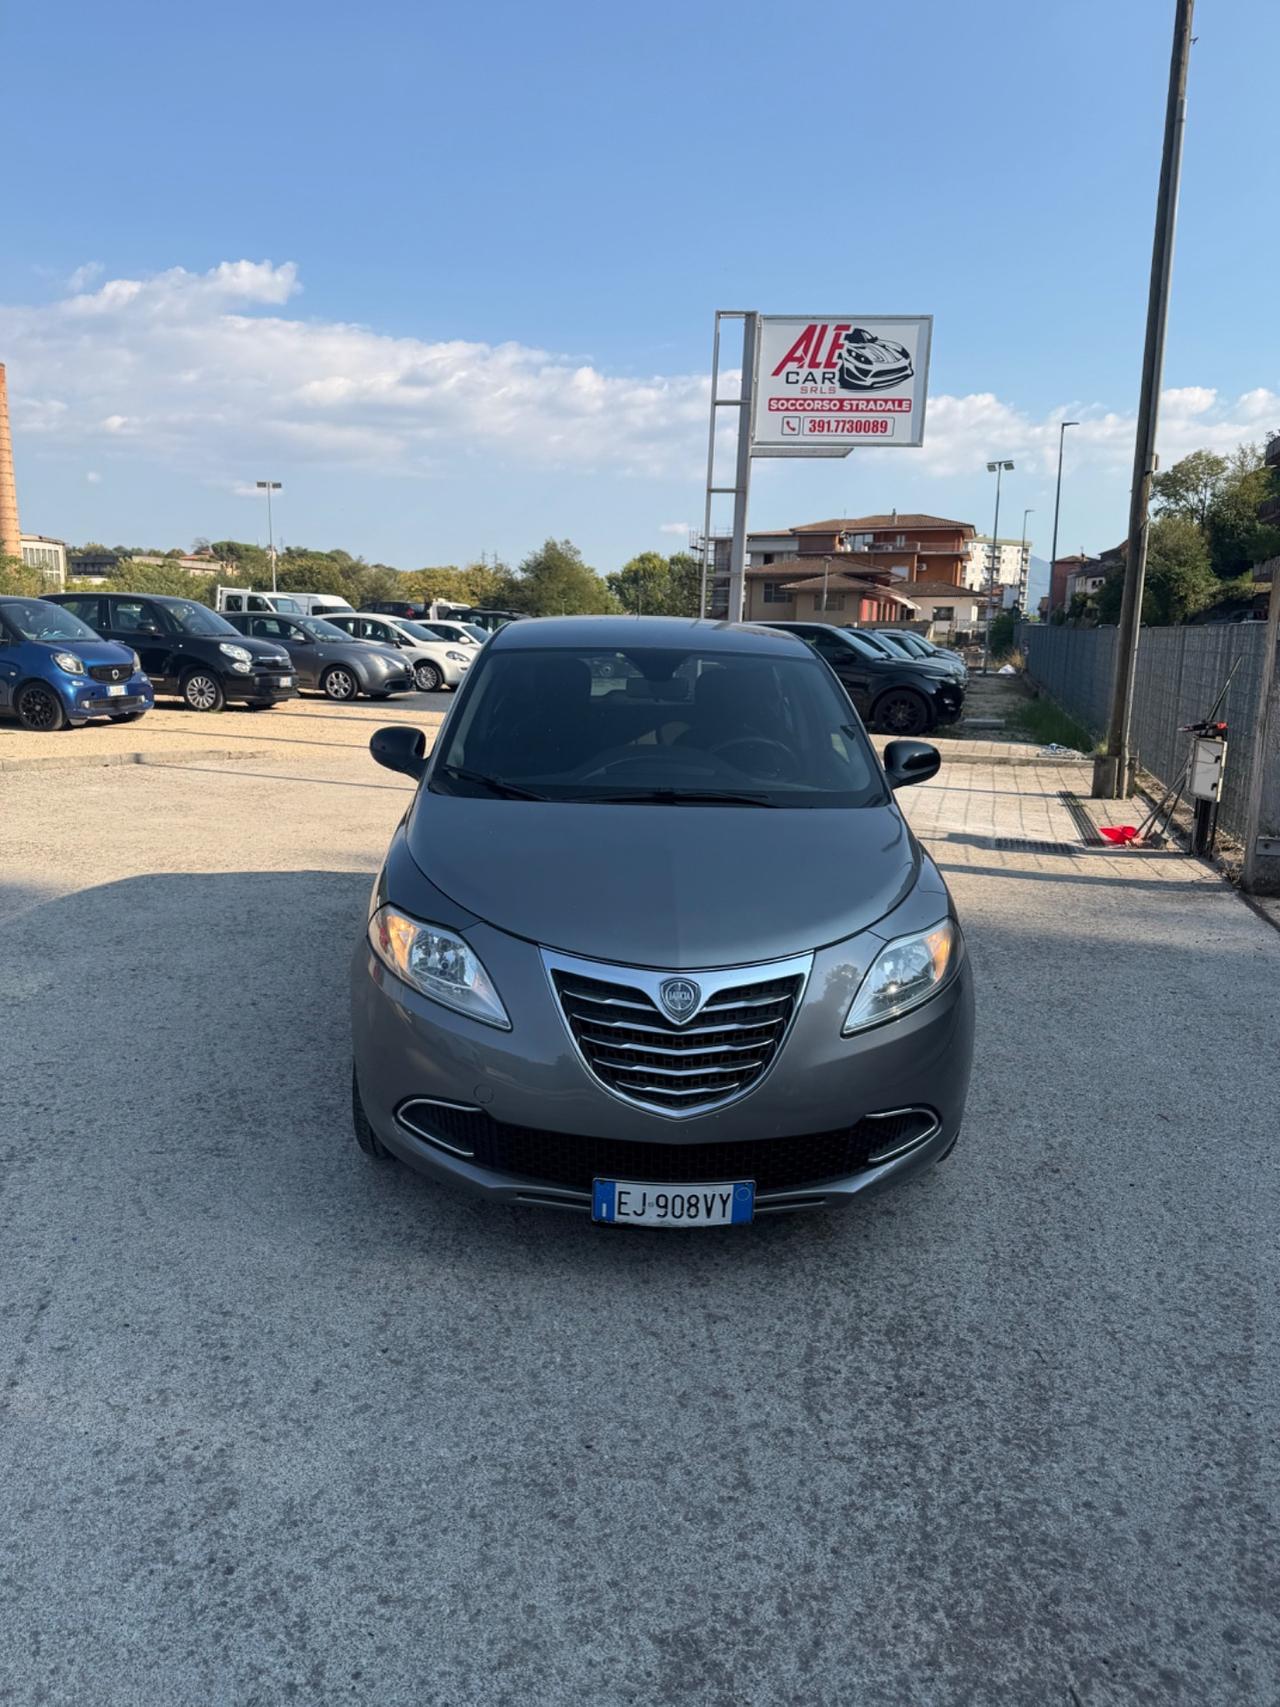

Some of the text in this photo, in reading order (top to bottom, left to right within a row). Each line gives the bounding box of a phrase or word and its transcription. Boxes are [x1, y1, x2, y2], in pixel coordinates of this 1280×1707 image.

[771, 324, 852, 377] ALE
[785, 371, 836, 385] CAR
[800, 386, 836, 394] SRLS
[770, 399, 910, 411] SOCCORSO STRADALE
[808, 419, 888, 434] 391.7730089
